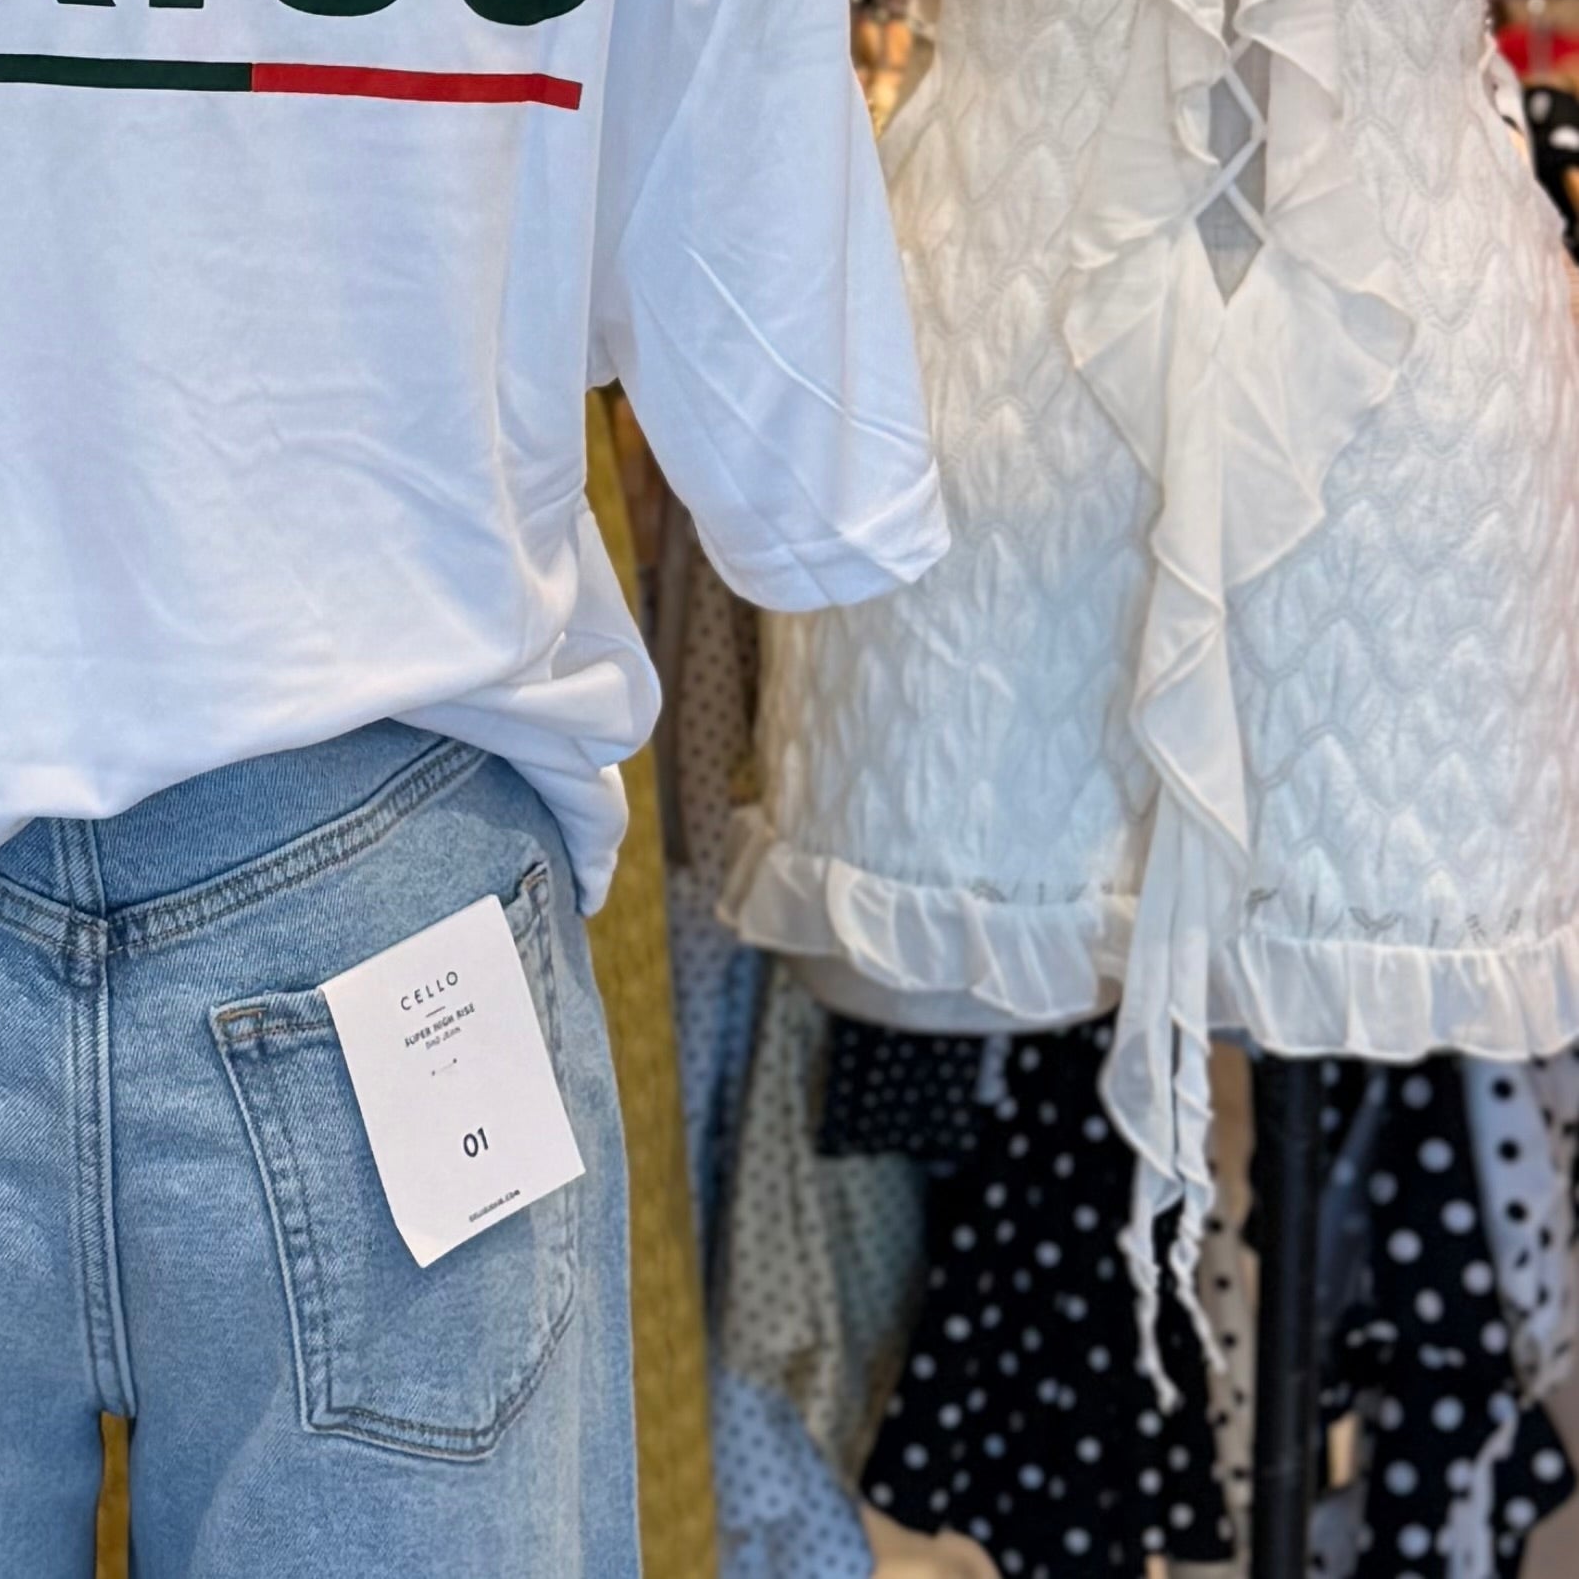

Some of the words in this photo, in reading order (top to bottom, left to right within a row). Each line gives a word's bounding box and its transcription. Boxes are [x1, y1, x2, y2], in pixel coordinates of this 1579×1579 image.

[400, 971, 459, 1011] CELLO
[404, 1026, 432, 1049] SUPER
[432, 1014, 455, 1032] HIGH
[455, 1002, 476, 1021] RISE
[463, 1126, 489, 1158] 01
